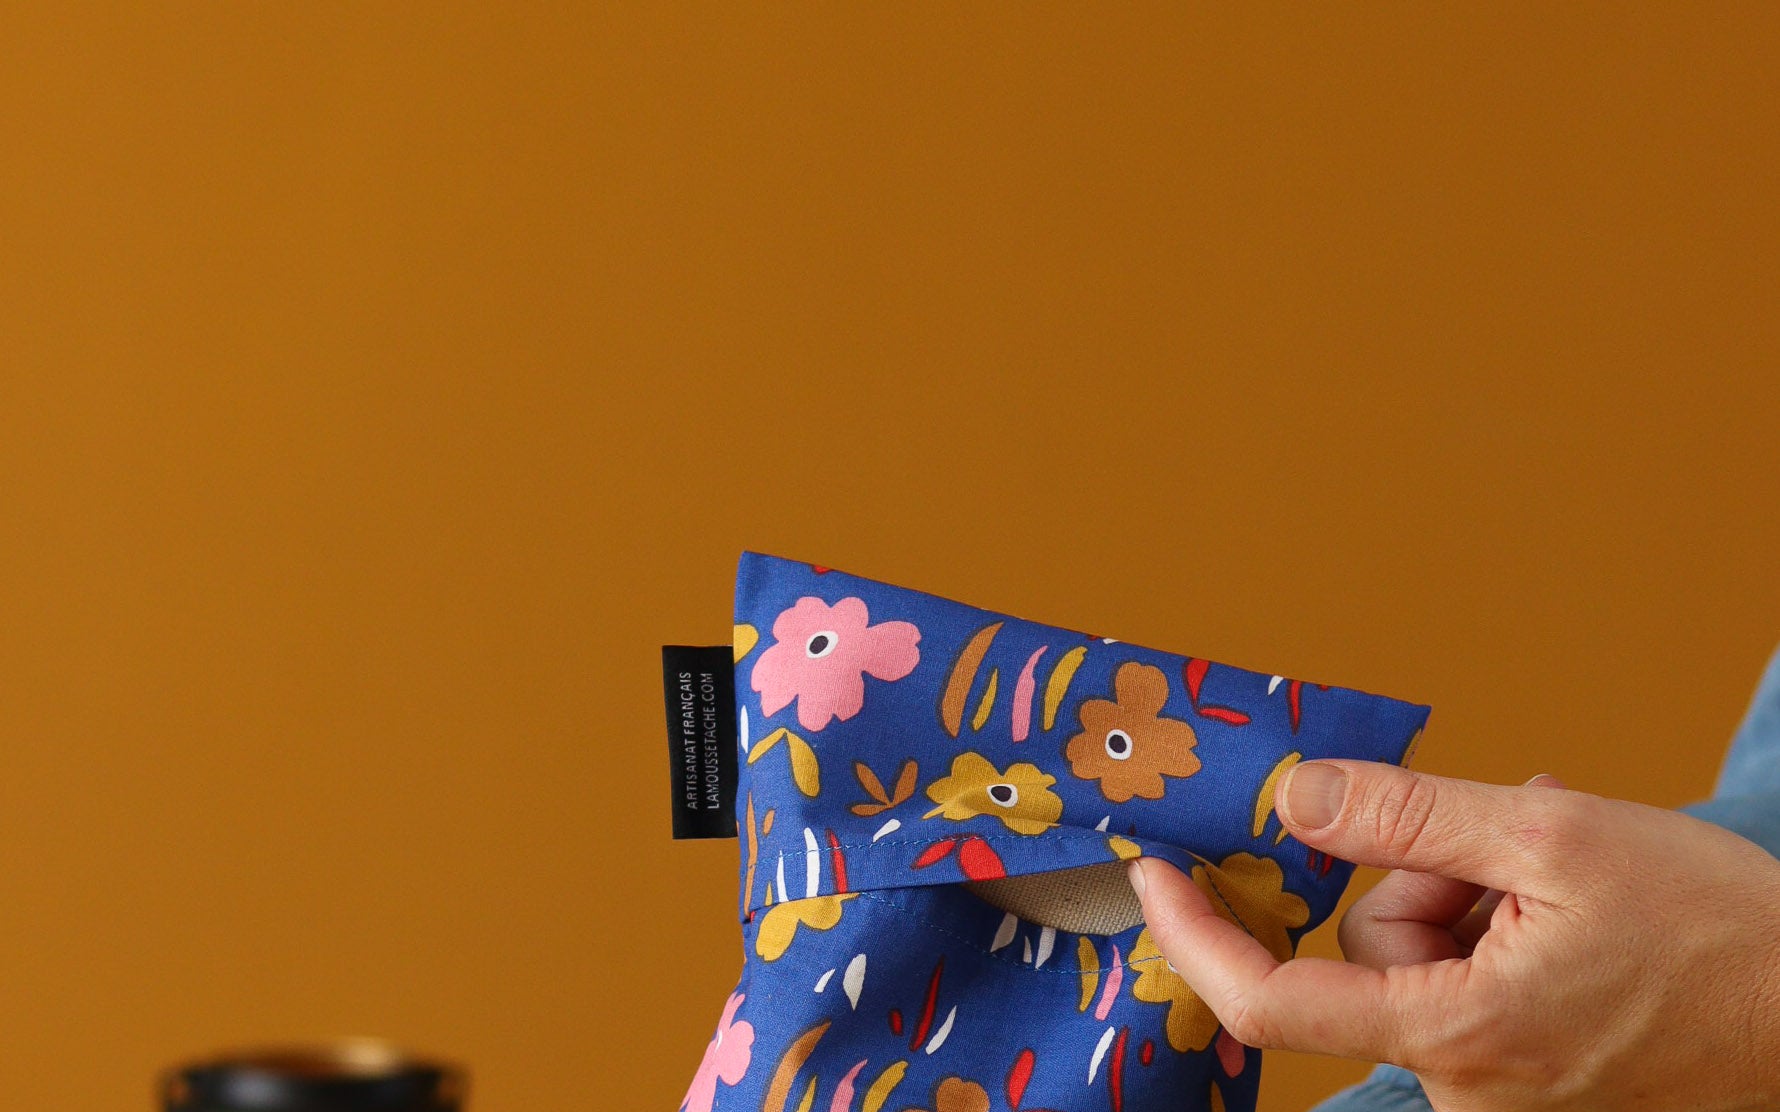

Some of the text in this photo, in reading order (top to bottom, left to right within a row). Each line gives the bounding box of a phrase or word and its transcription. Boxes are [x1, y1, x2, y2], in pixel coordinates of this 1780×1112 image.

[679, 671, 698, 810] ARTISANAT FRANÇAIS
[700, 672, 720, 810] LAMOUSSETACHE.COM
